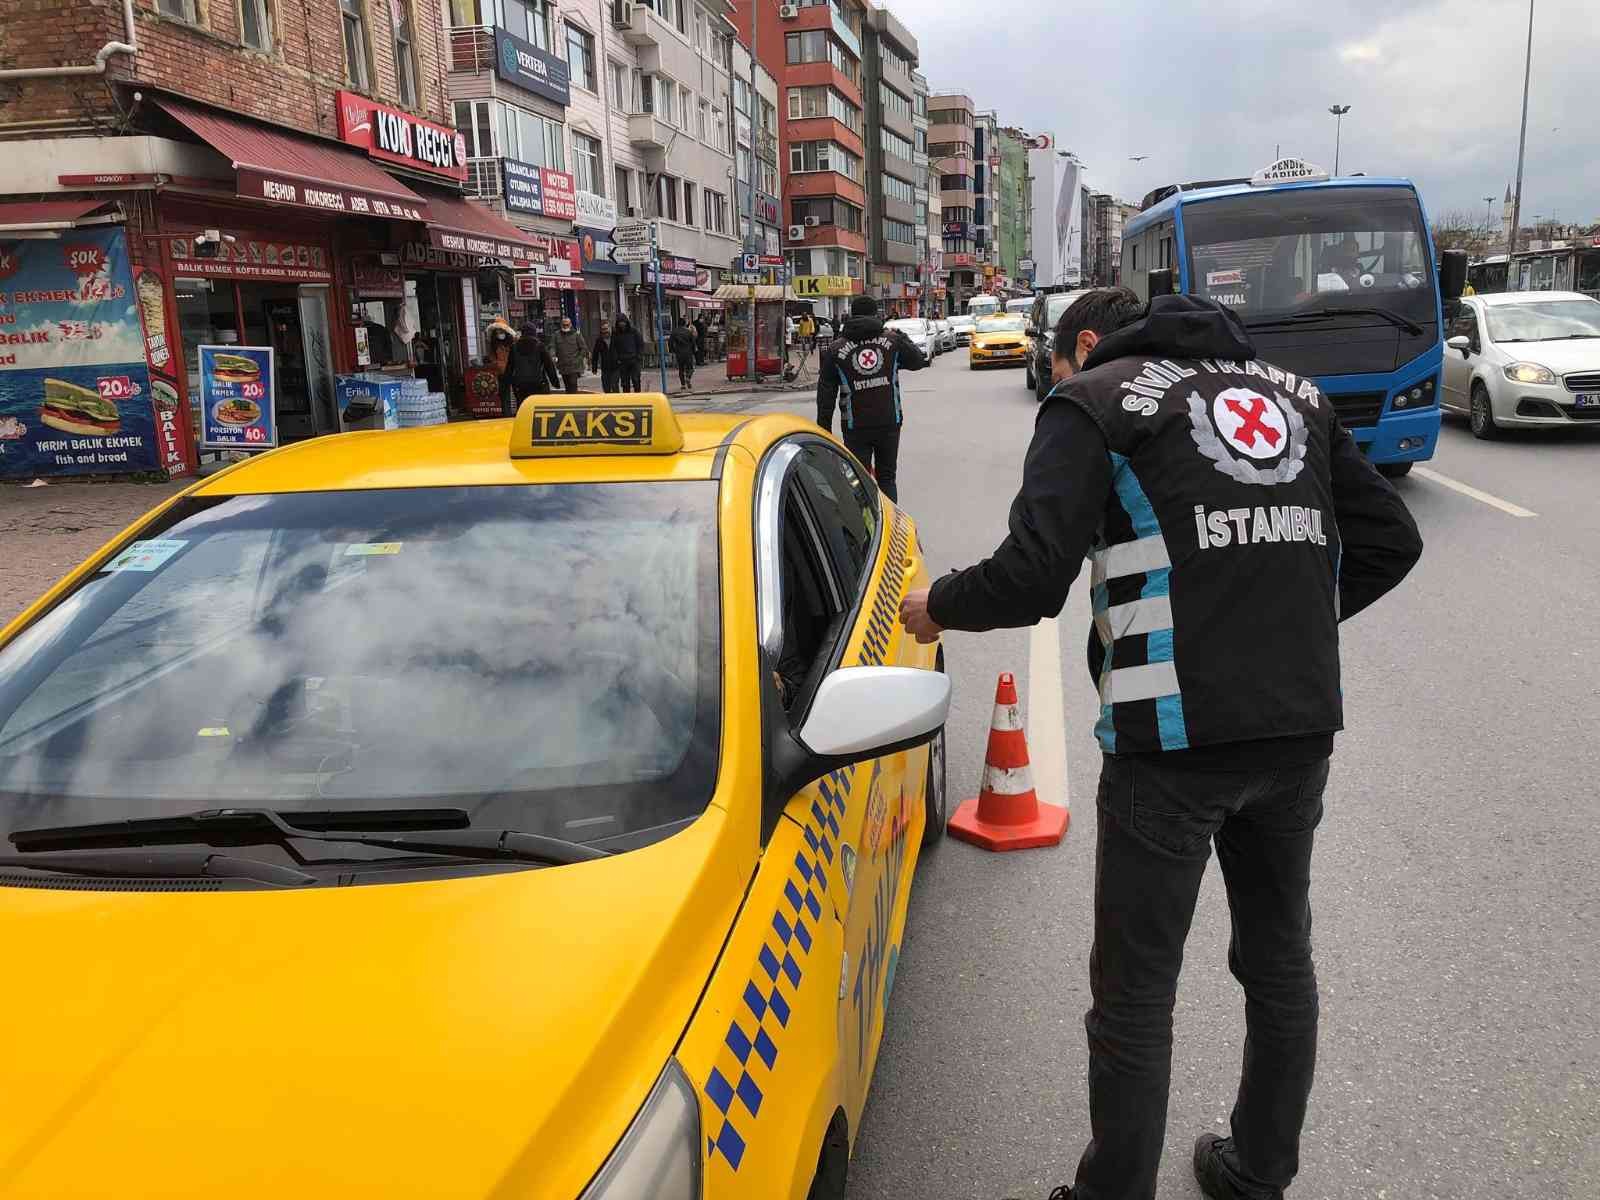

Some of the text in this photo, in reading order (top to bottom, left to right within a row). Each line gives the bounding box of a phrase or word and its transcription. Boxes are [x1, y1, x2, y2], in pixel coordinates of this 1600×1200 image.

[70, 250, 98, 269] ŞOK
[177, 263, 204, 272] BALIK
[521, 280, 533, 295] E
[1121, 359, 1198, 416] SİVİL
[534, 411, 649, 438] TAKSİ
[36, 437, 143, 452] YARIM BALIK EKMEK
[55, 452, 128, 465] fish and bread
[1193, 504, 1327, 550] İSTANBUL
